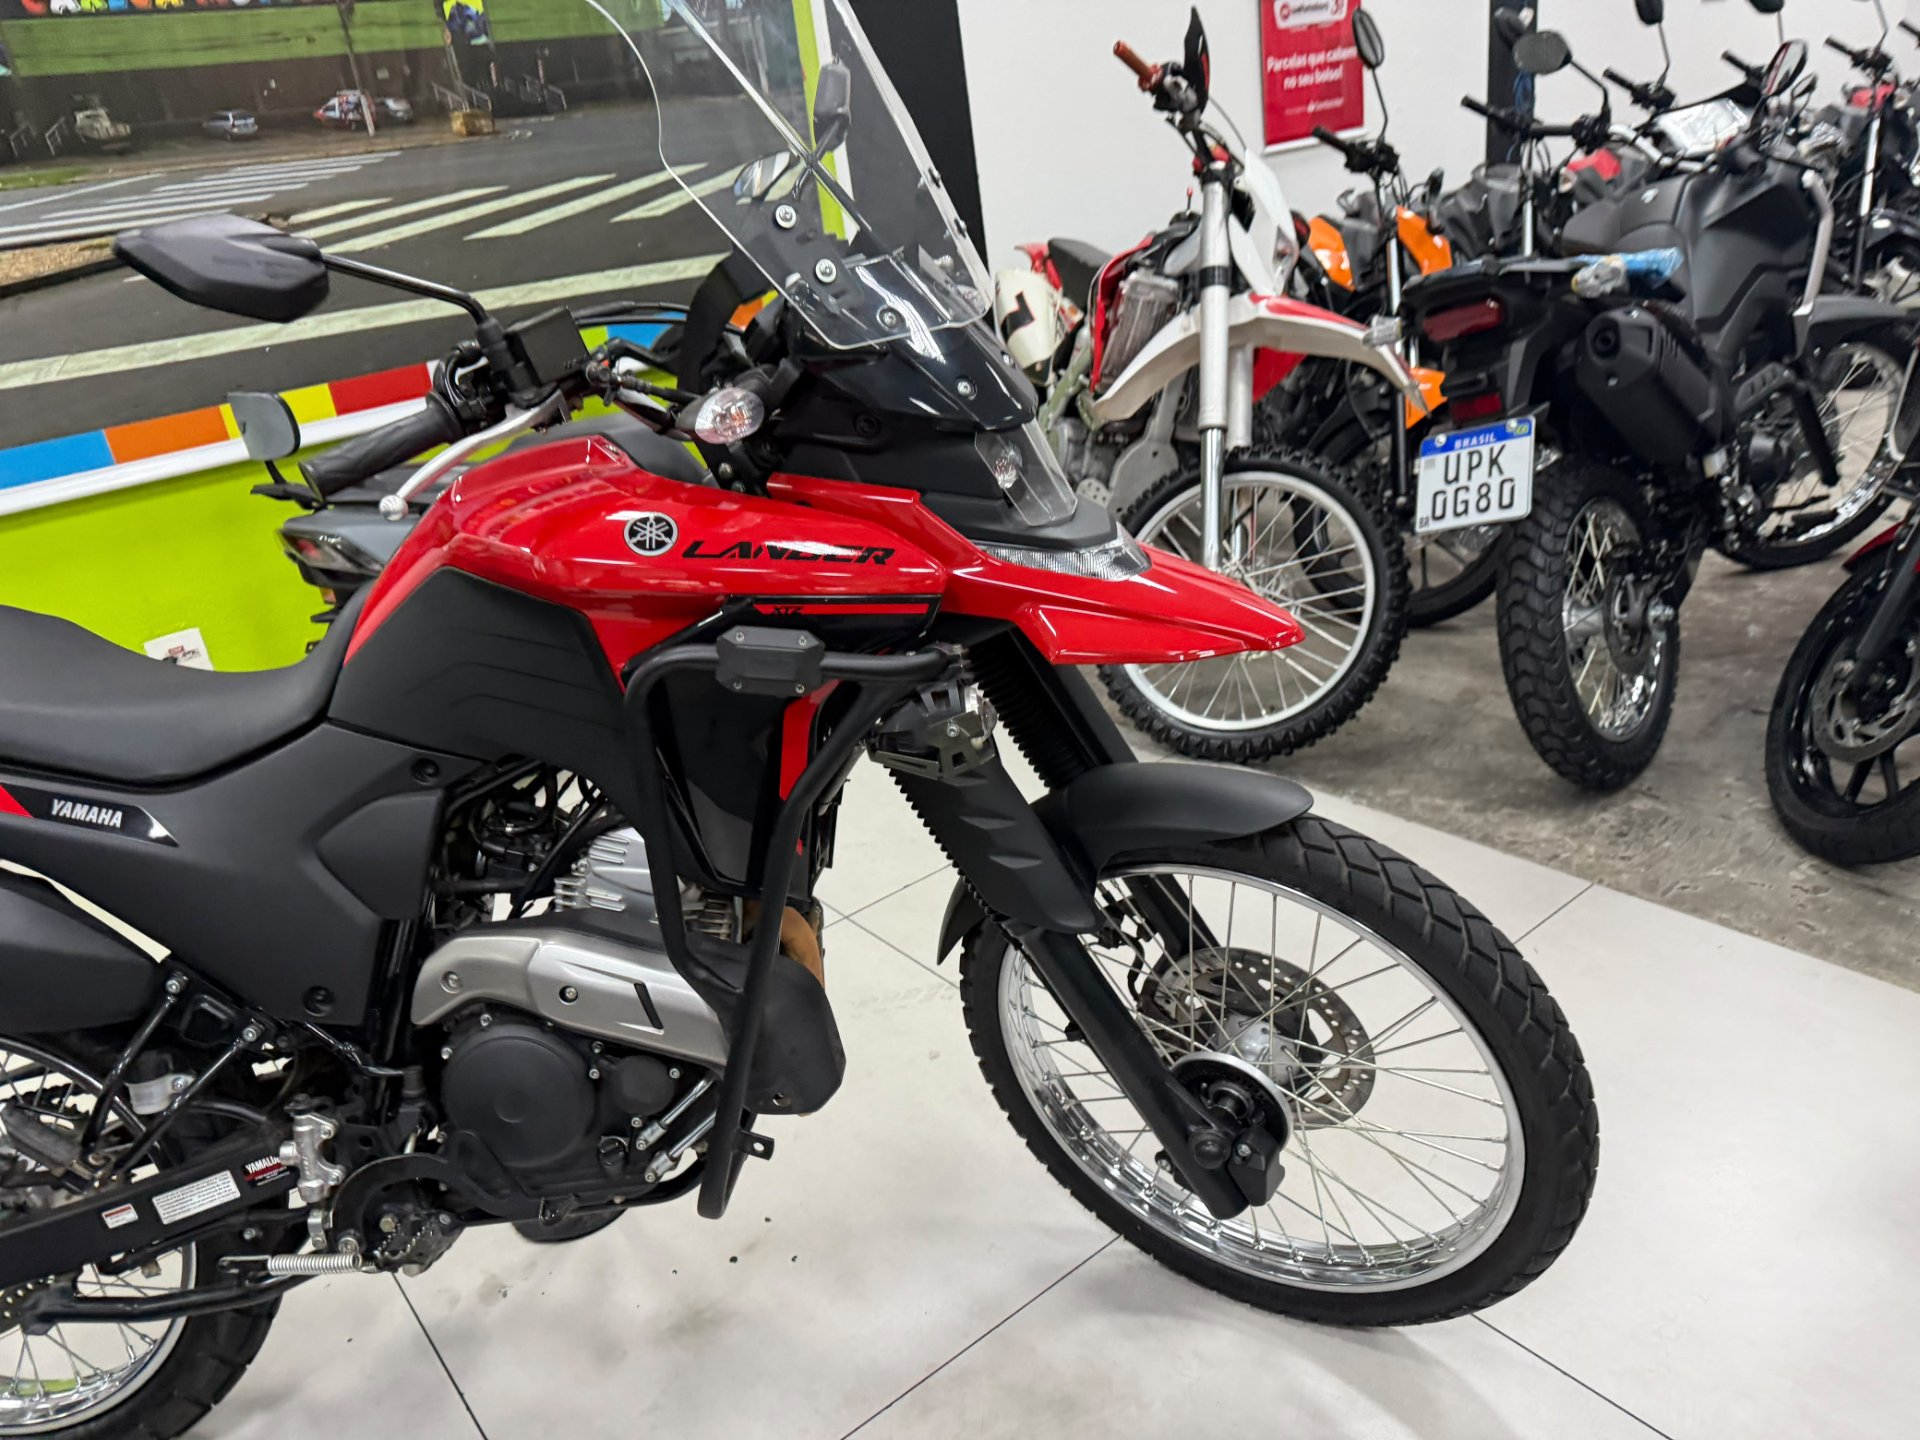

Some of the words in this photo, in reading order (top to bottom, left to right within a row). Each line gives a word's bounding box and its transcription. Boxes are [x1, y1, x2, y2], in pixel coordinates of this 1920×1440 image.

[1454, 432, 1497, 450] BRASIL
[1445, 444, 1506, 484] UPK
[1432, 478, 1515, 520] 0G80
[1419, 516, 1430, 529] BR
[773, 605, 804, 615] XTZ
[51, 798, 123, 828] YAMAHA
